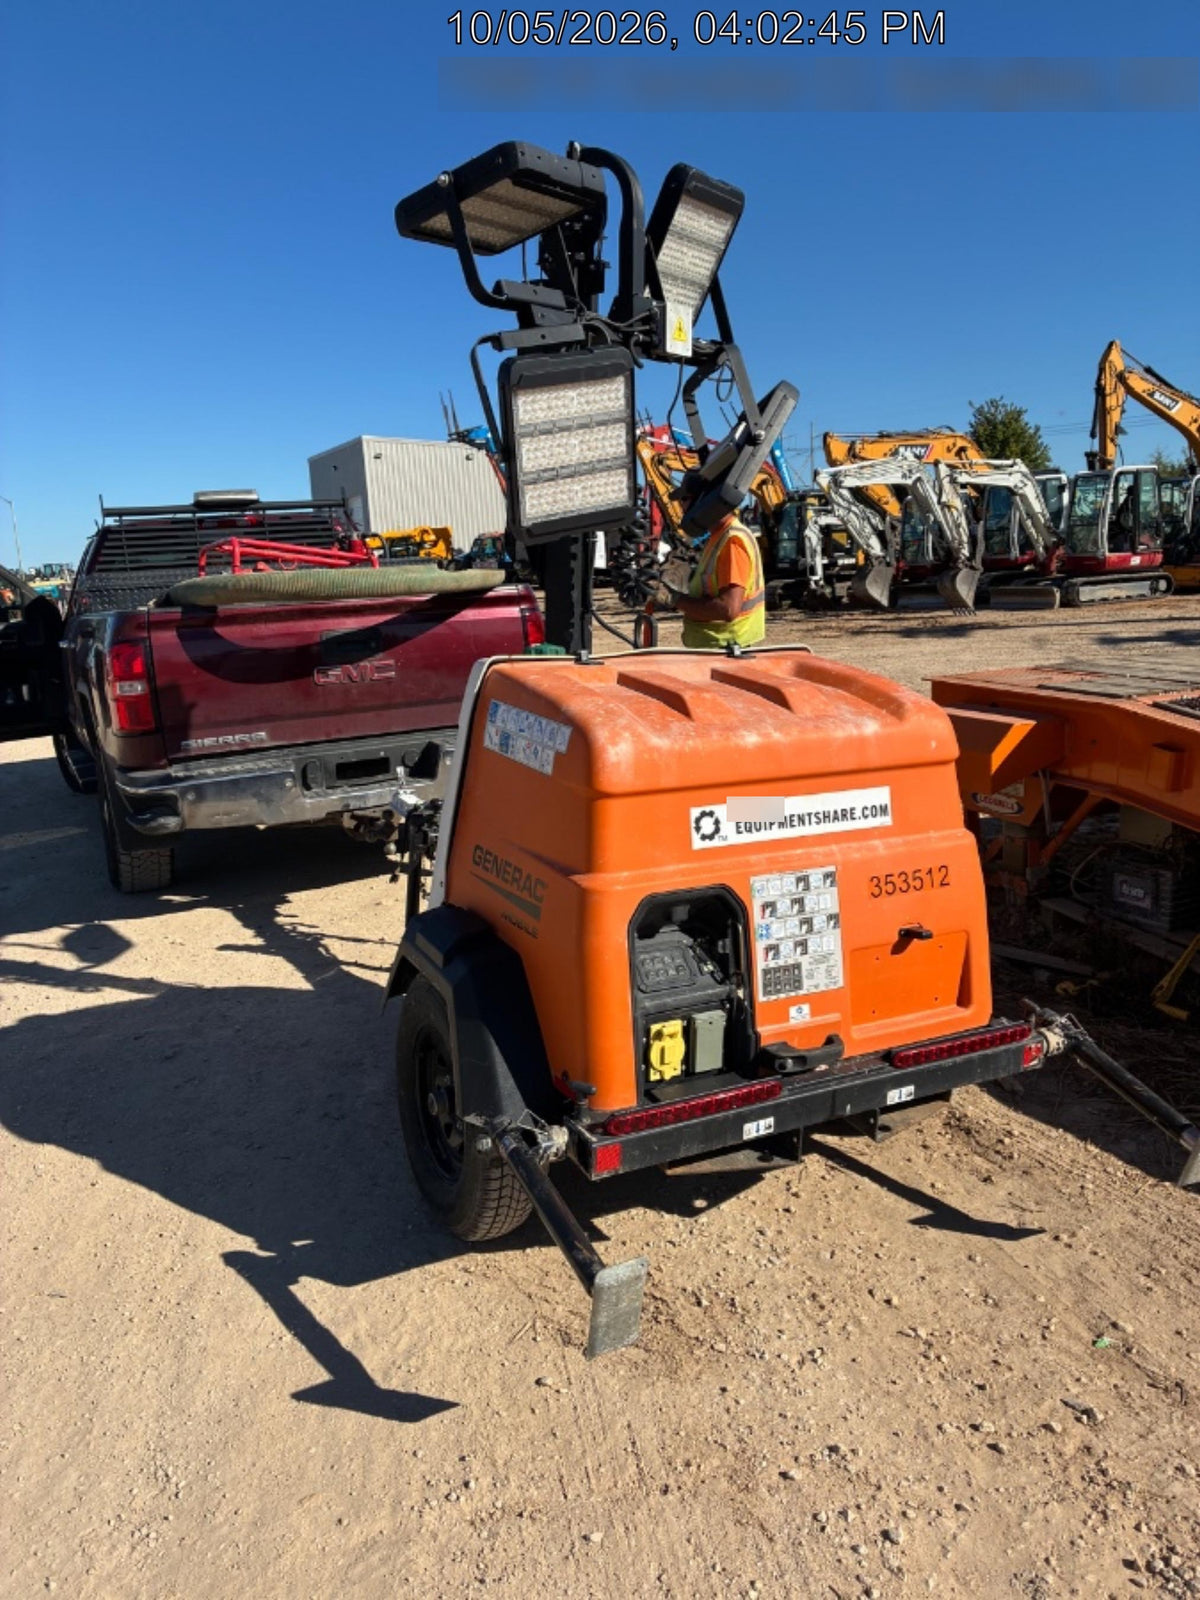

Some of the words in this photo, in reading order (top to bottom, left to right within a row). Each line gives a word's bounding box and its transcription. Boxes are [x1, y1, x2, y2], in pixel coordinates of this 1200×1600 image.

[314, 659, 396, 685] GMC
[181, 731, 267, 749] SIERRA
[472, 844, 546, 904] GENERAC
[869, 864, 951, 899] 353512
